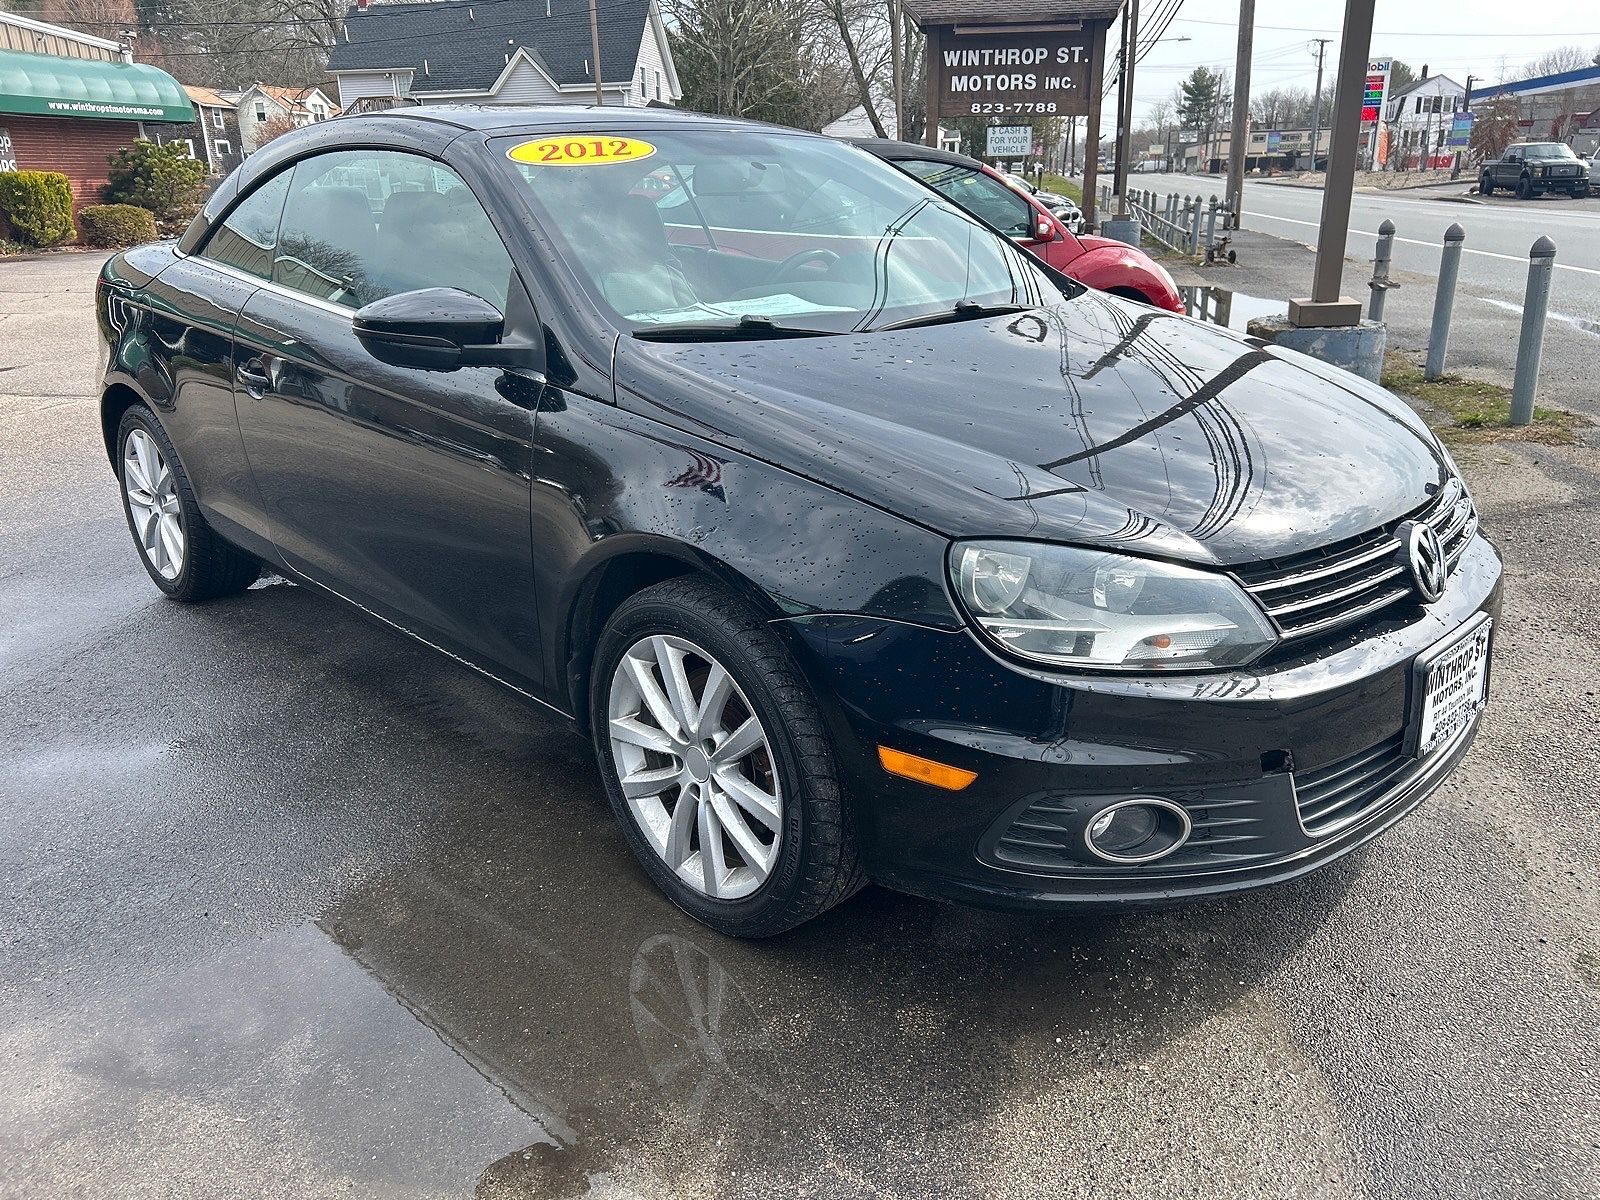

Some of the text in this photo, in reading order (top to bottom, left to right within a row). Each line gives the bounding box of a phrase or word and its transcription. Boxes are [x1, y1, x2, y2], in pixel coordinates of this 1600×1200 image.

[943, 46, 1089, 67] WINTHROP ST.
[951, 74, 1077, 92] MOTORS INC.
[48, 101, 164, 116] www.winthropstmotorsma.com
[970, 102, 1058, 114] 823-7788
[999, 126, 1020, 135] CASH
[990, 136, 1029, 145] FOR YOUR
[538, 140, 632, 162] 2012
[992, 145, 1026, 154] VEHICLE
[1426, 646, 1474, 696] WINTHROP
[1474, 636, 1487, 662] ST.
